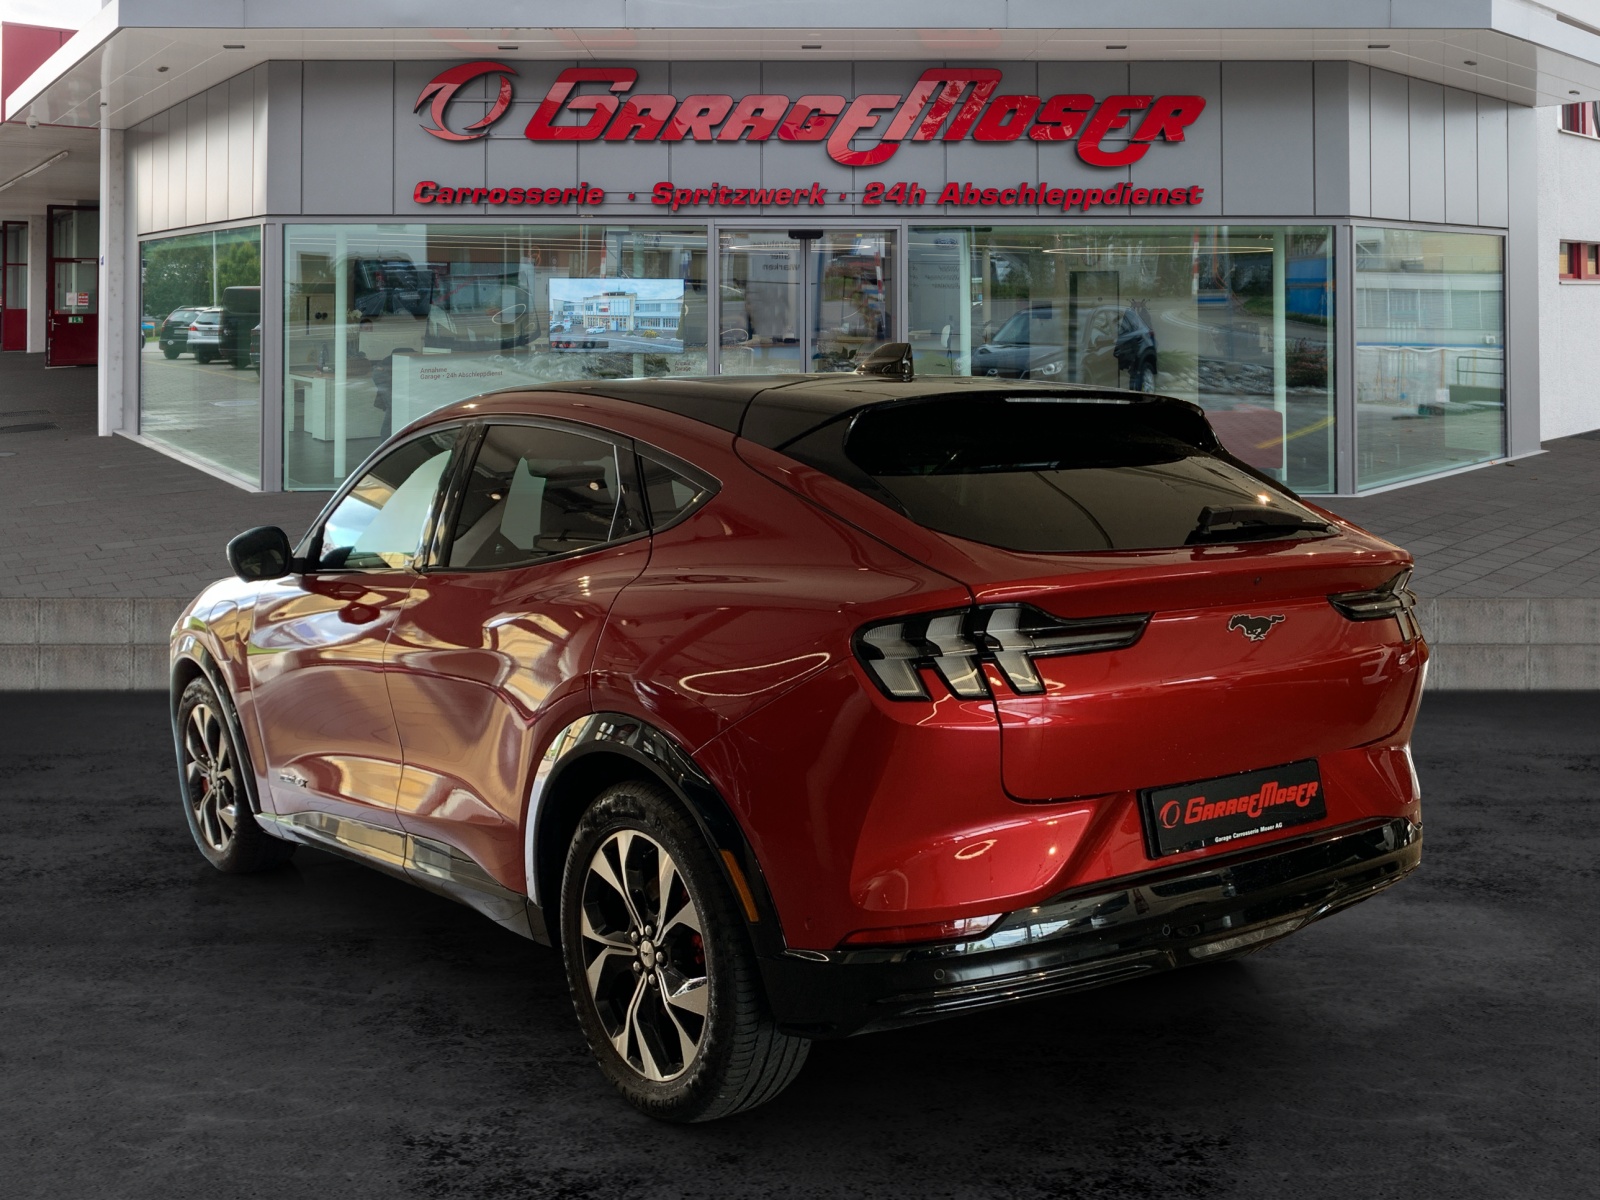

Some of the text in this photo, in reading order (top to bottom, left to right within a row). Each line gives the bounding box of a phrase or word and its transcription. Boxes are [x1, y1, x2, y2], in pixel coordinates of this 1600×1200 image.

[413, 180, 1205, 212] Carrosserie Spritzwerk 24h Abschleppdienst
[419, 373, 441, 381] Garage
[458, 370, 503, 378] Abschleppdienst
[1214, 834, 1232, 843] Garage
[1233, 828, 1259, 839] Carrosserie
[1260, 824, 1275, 833] Moser
